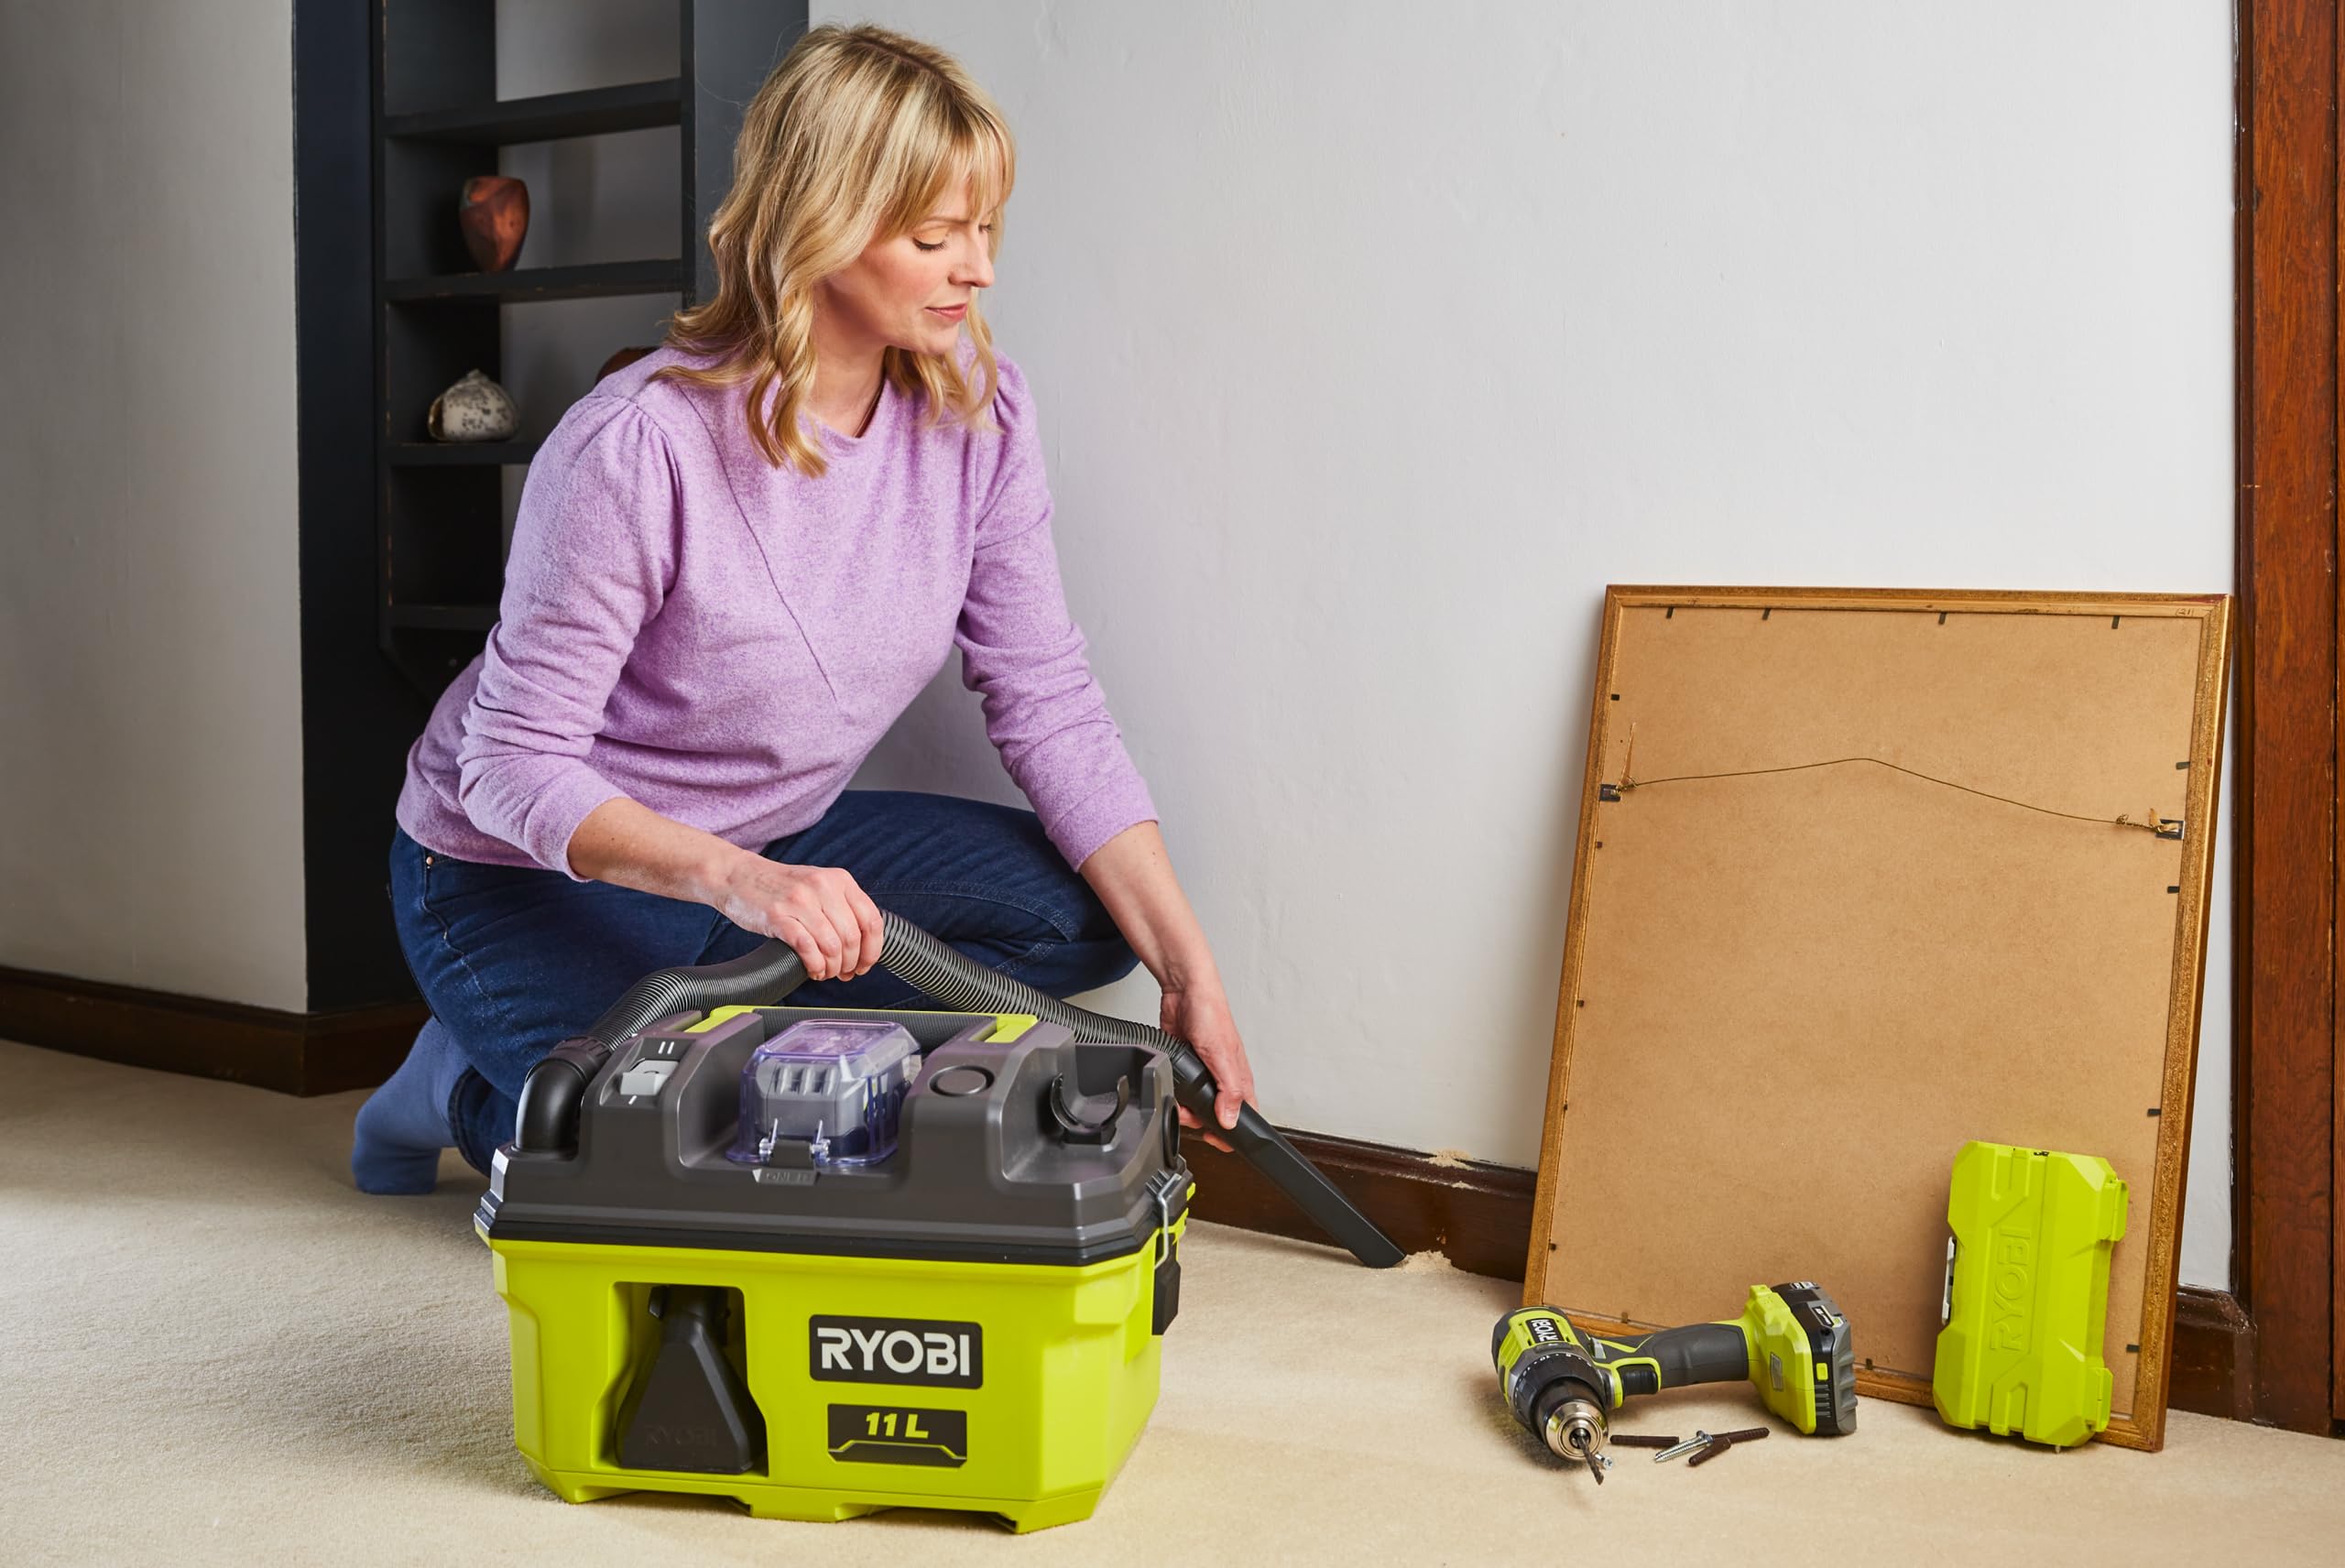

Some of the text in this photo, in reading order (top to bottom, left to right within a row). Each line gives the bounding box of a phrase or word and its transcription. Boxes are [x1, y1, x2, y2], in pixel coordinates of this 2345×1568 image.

[1989, 1225, 2031, 1351] RYOBI
[1531, 1319, 1559, 1343] RYOBI
[817, 1327, 970, 1377] RYOBI
[866, 1411, 929, 1439] 11 L
